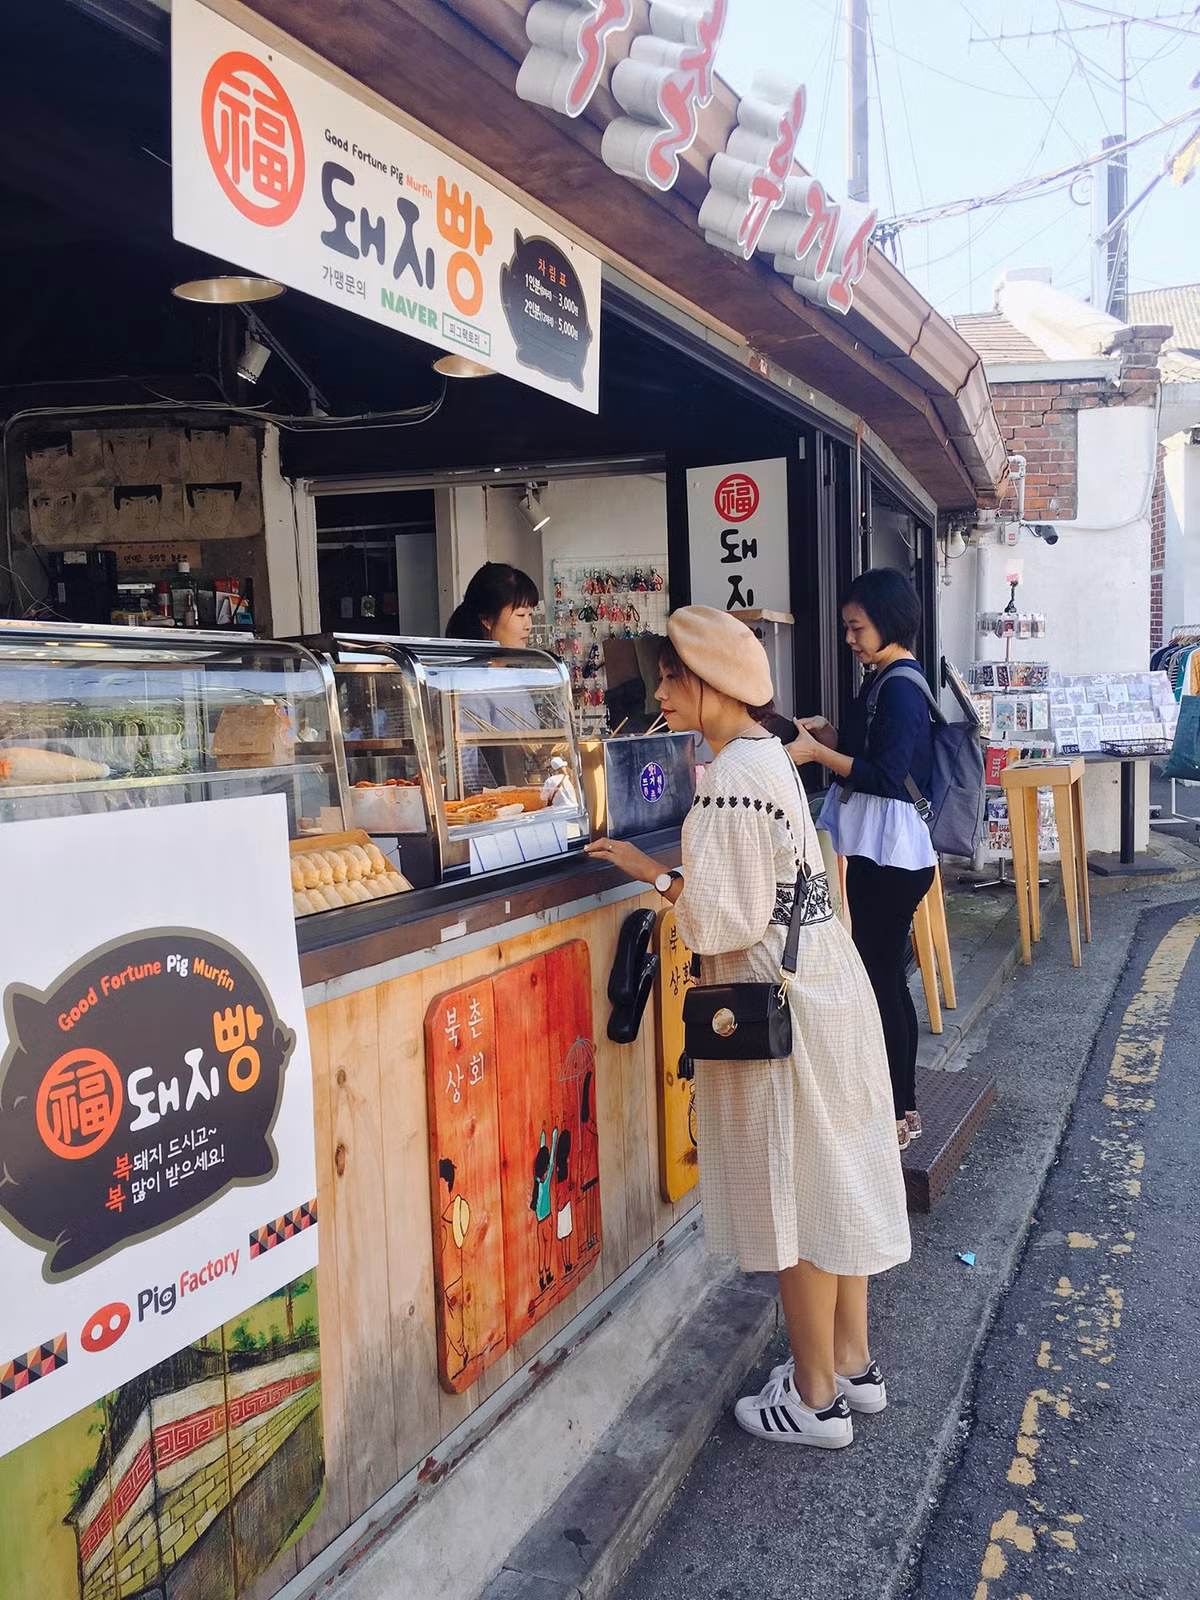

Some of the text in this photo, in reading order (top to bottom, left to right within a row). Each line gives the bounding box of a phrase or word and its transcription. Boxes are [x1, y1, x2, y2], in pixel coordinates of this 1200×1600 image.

[208, 64, 296, 212] 福
[325, 129, 433, 200] Good Fortune Pig Murfin
[322, 266, 366, 299] 가맹문의
[380, 287, 438, 330] NAVER
[718, 478, 756, 518] 福
[991, 758, 1001, 778] BTS
[57, 954, 235, 1031] Good Fortune Pig Murfin
[444, 998, 484, 1048] 북촌
[445, 1052, 485, 1104] 상회
[44, 1057, 116, 1152] 福
[167, 1127, 217, 1159] 드시고~
[105, 1144, 225, 1213] 복 많이 받으세요!
[137, 1248, 240, 1323] Pig Factory
